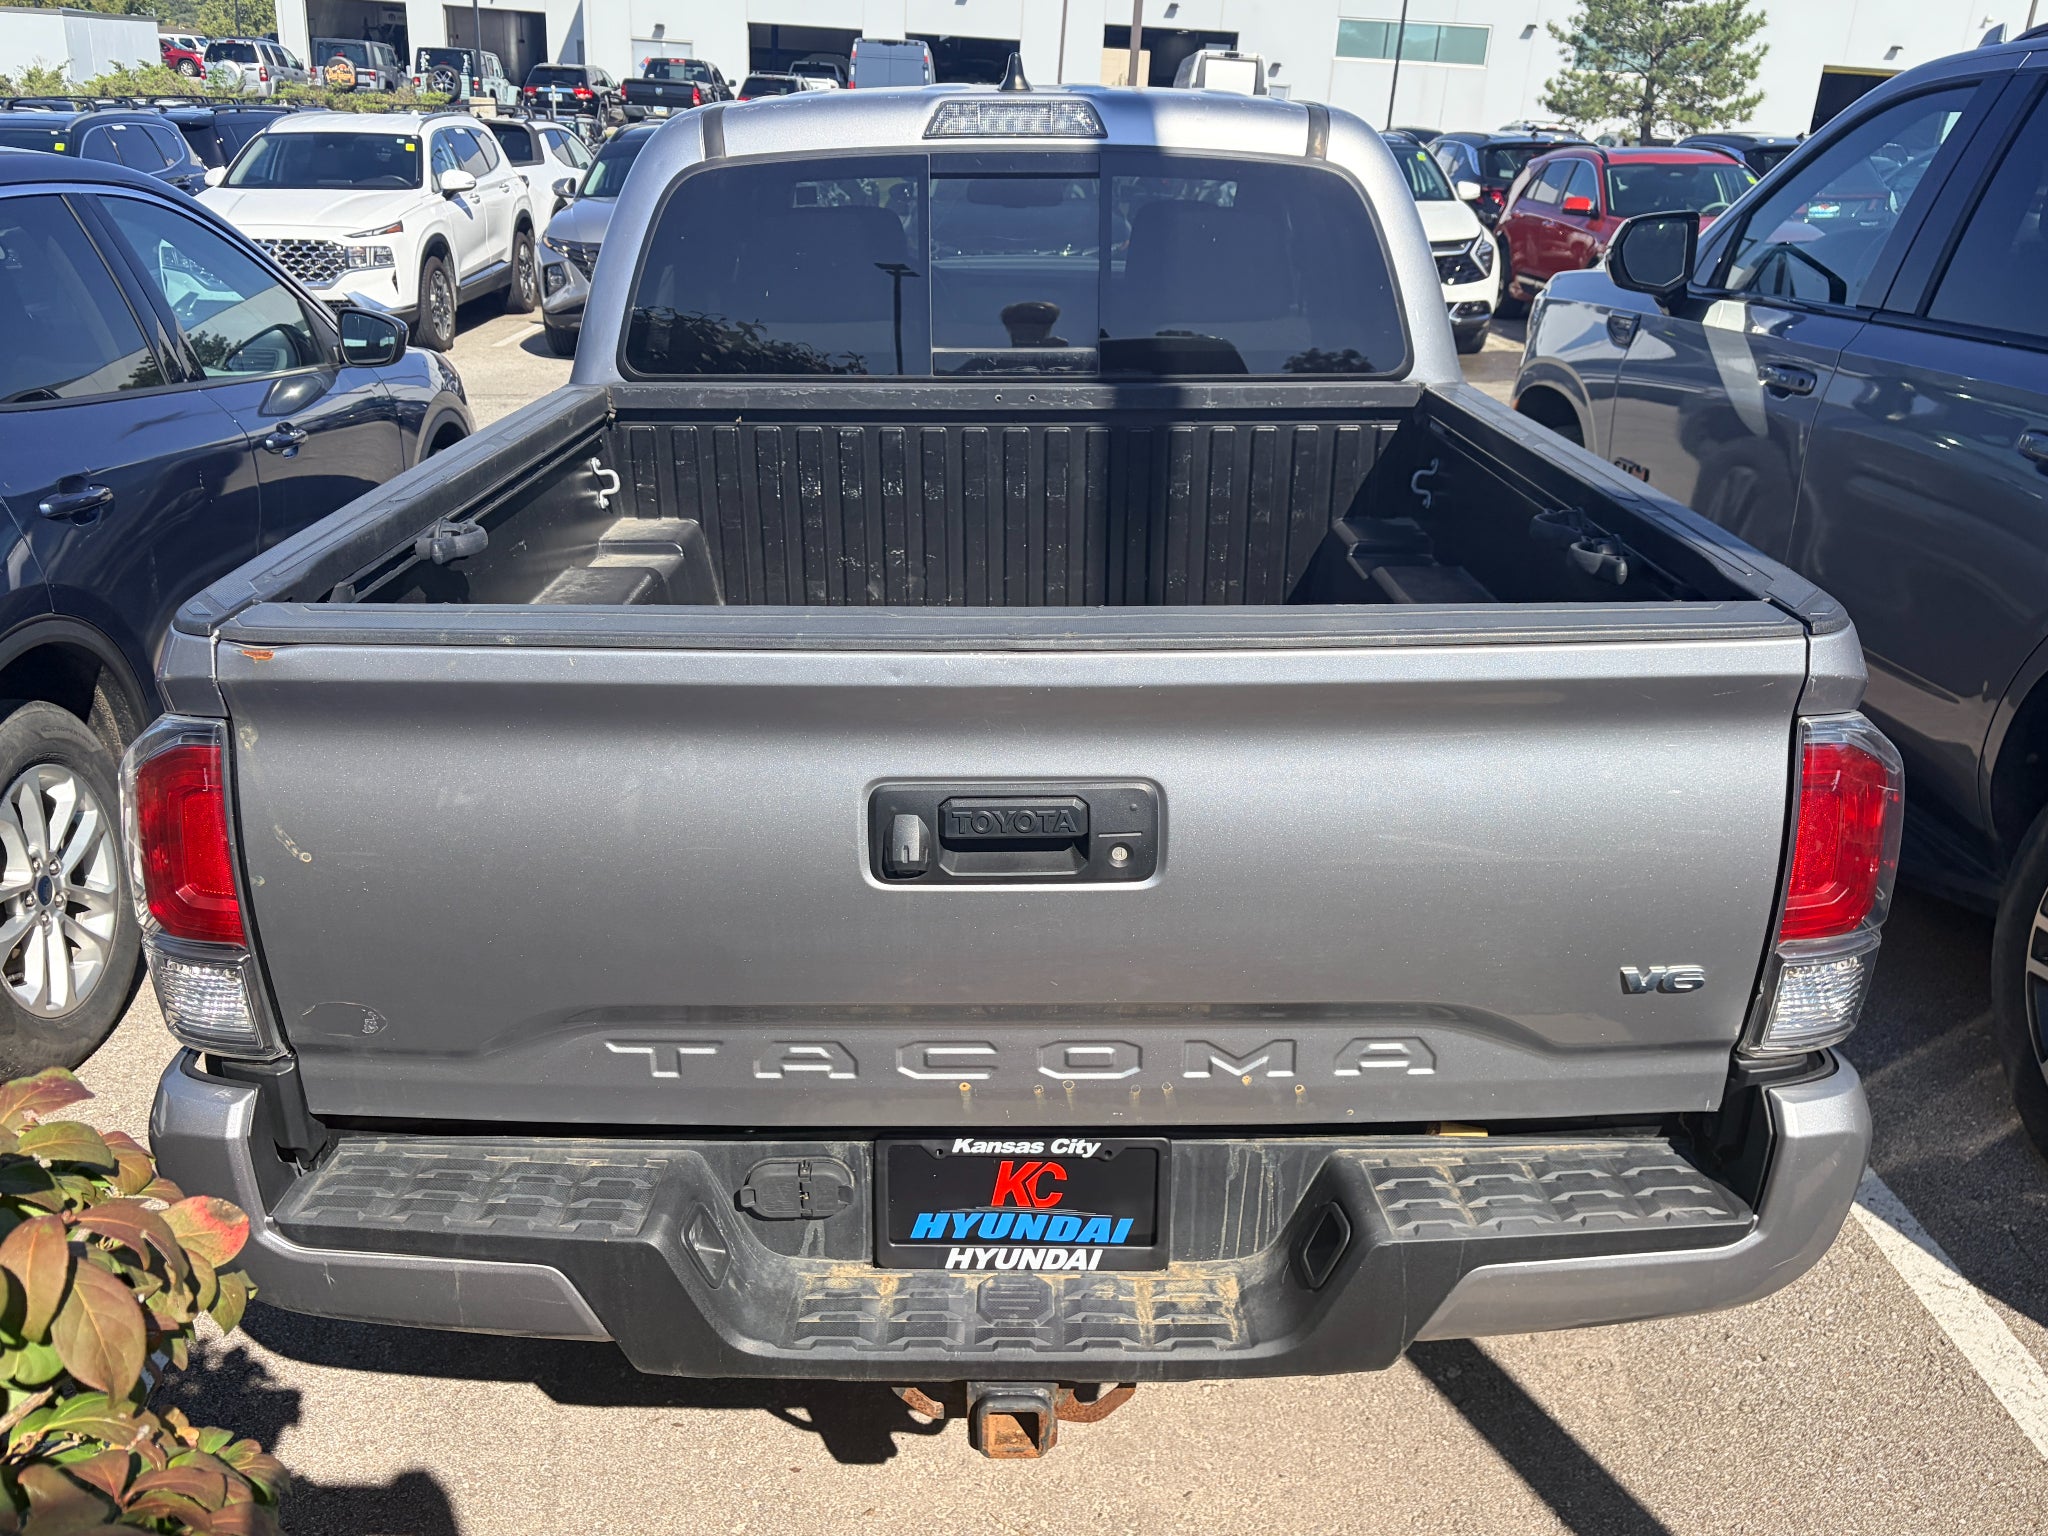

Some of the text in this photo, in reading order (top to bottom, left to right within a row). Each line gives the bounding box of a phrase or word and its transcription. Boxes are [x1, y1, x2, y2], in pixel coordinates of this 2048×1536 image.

[951, 809, 1078, 835] TOYOTA
[1620, 964, 1705, 994] V6
[604, 1036, 1437, 1080] TACOMA
[952, 1138, 1101, 1158] Kansas City
[991, 1160, 1068, 1208] KC
[910, 1212, 1134, 1244] HYUNDAI
[945, 1248, 1103, 1271] HYUNDAI
